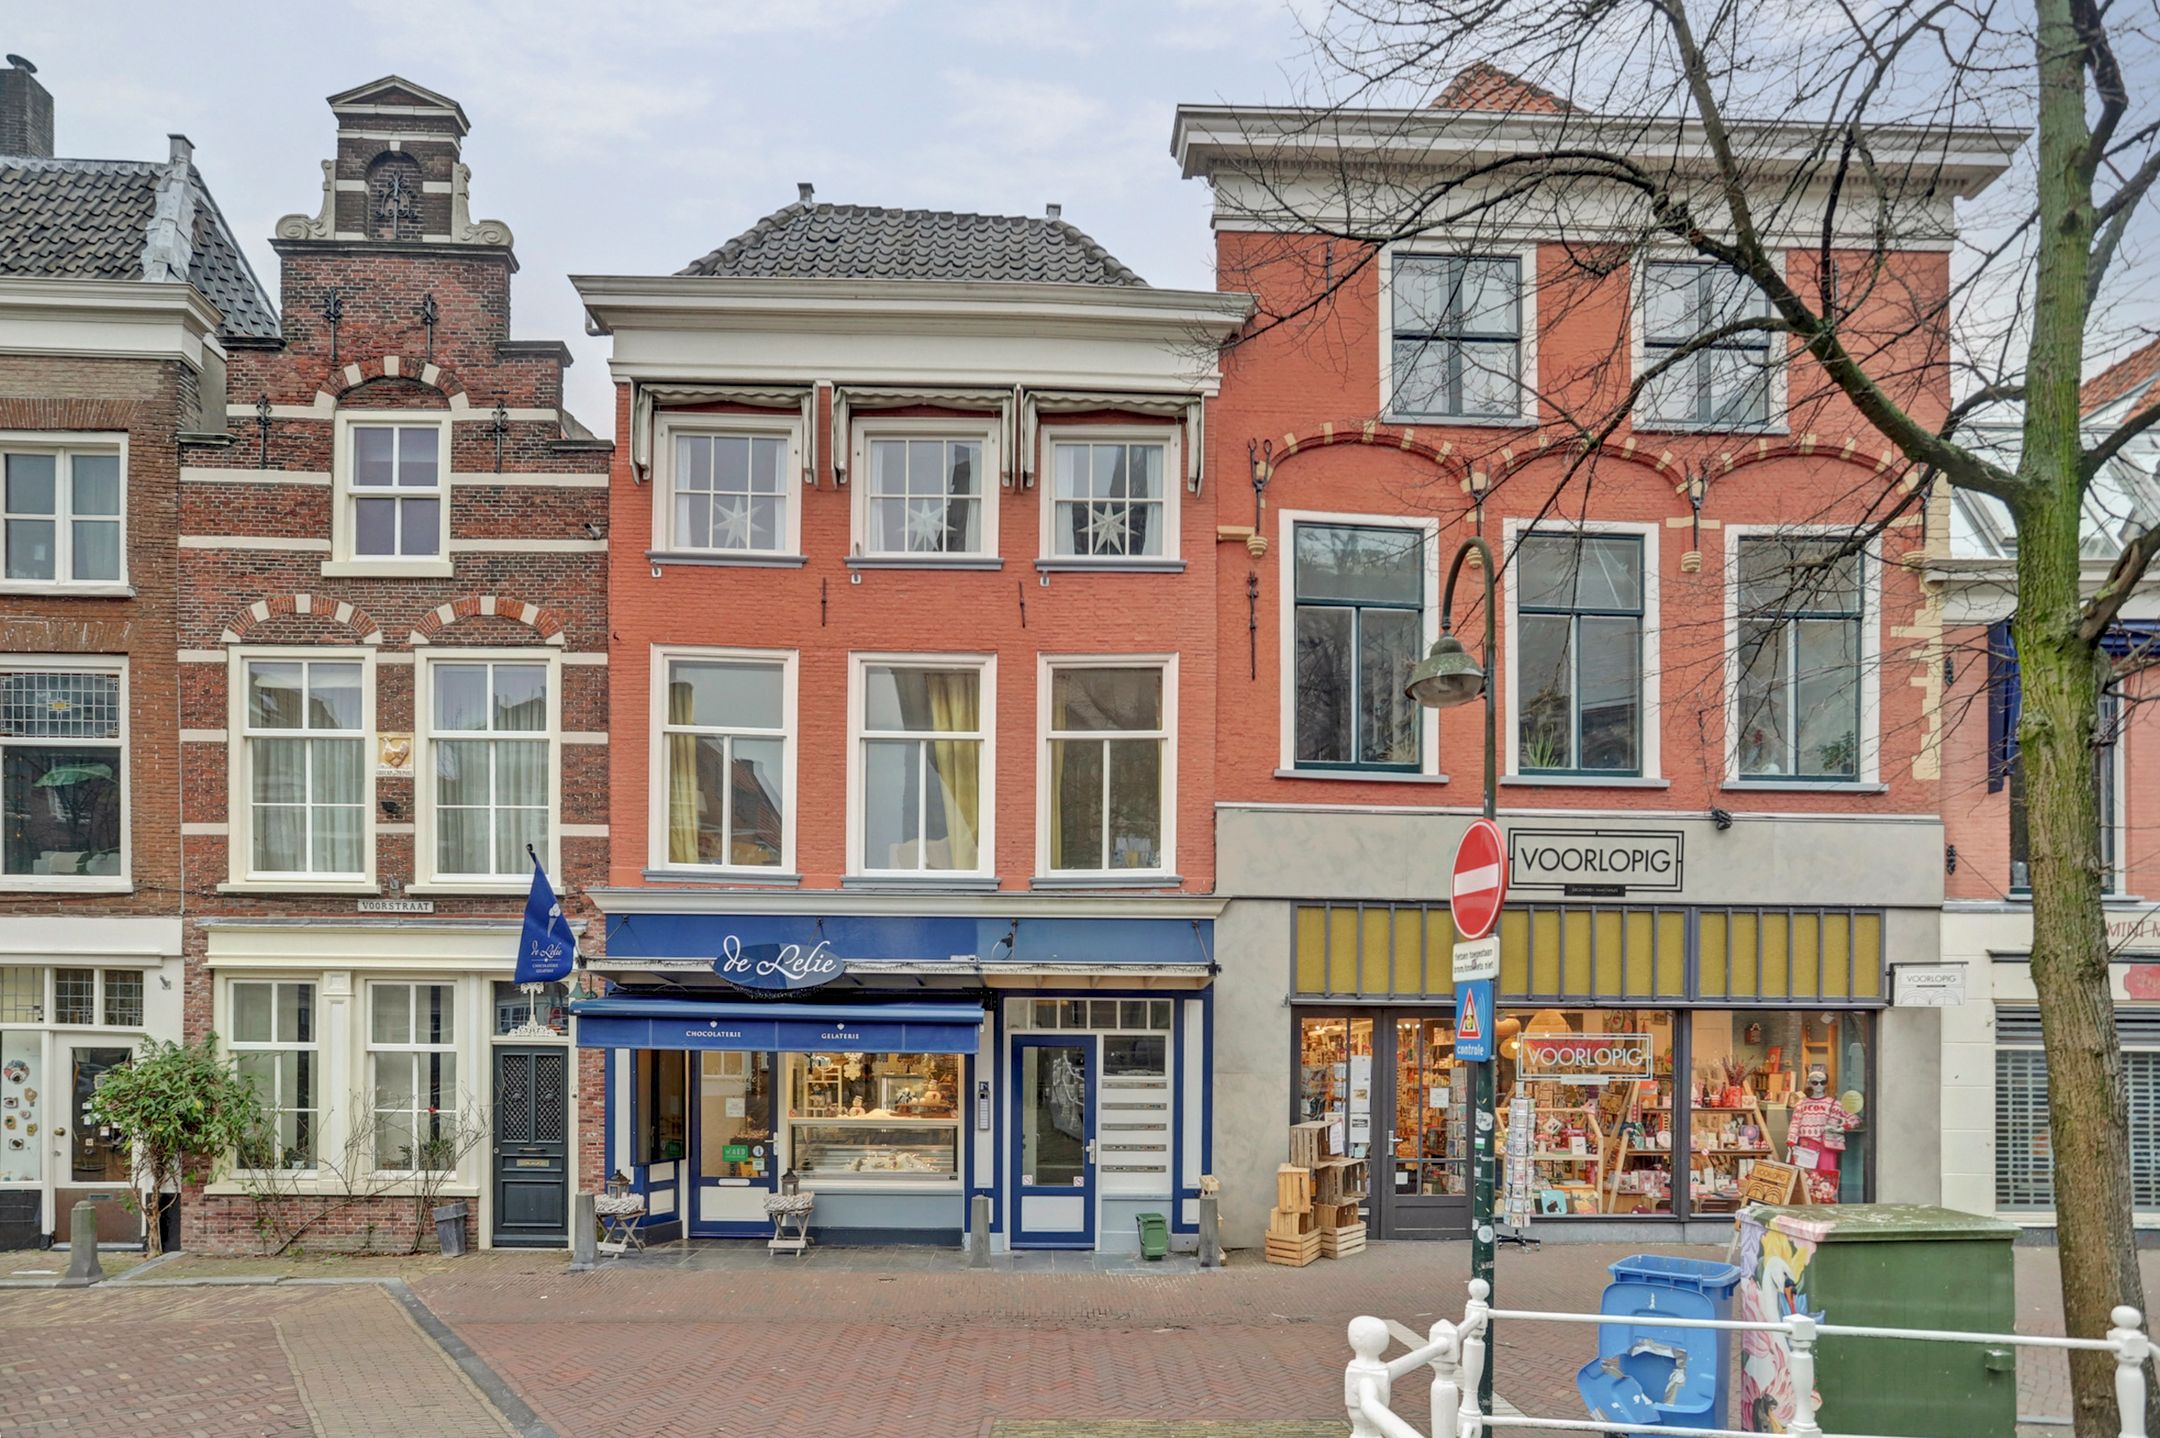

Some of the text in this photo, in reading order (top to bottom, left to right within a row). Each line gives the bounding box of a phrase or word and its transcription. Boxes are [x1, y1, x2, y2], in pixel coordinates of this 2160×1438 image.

[1520, 847, 1671, 873] VOORLOPIG
[362, 902, 429, 910] VOORSTRAAT
[2107, 921, 2144, 937] MINI
[723, 935, 837, 980] de Lelie
[1907, 975, 1956, 983] VOORLOPIG
[686, 1030, 741, 1038] CHOCOLATERIE
[821, 1032, 859, 1040] GELATERIE
[1457, 1045, 1485, 1056] controle
[1527, 1047, 1643, 1066] VOORLOPIG
